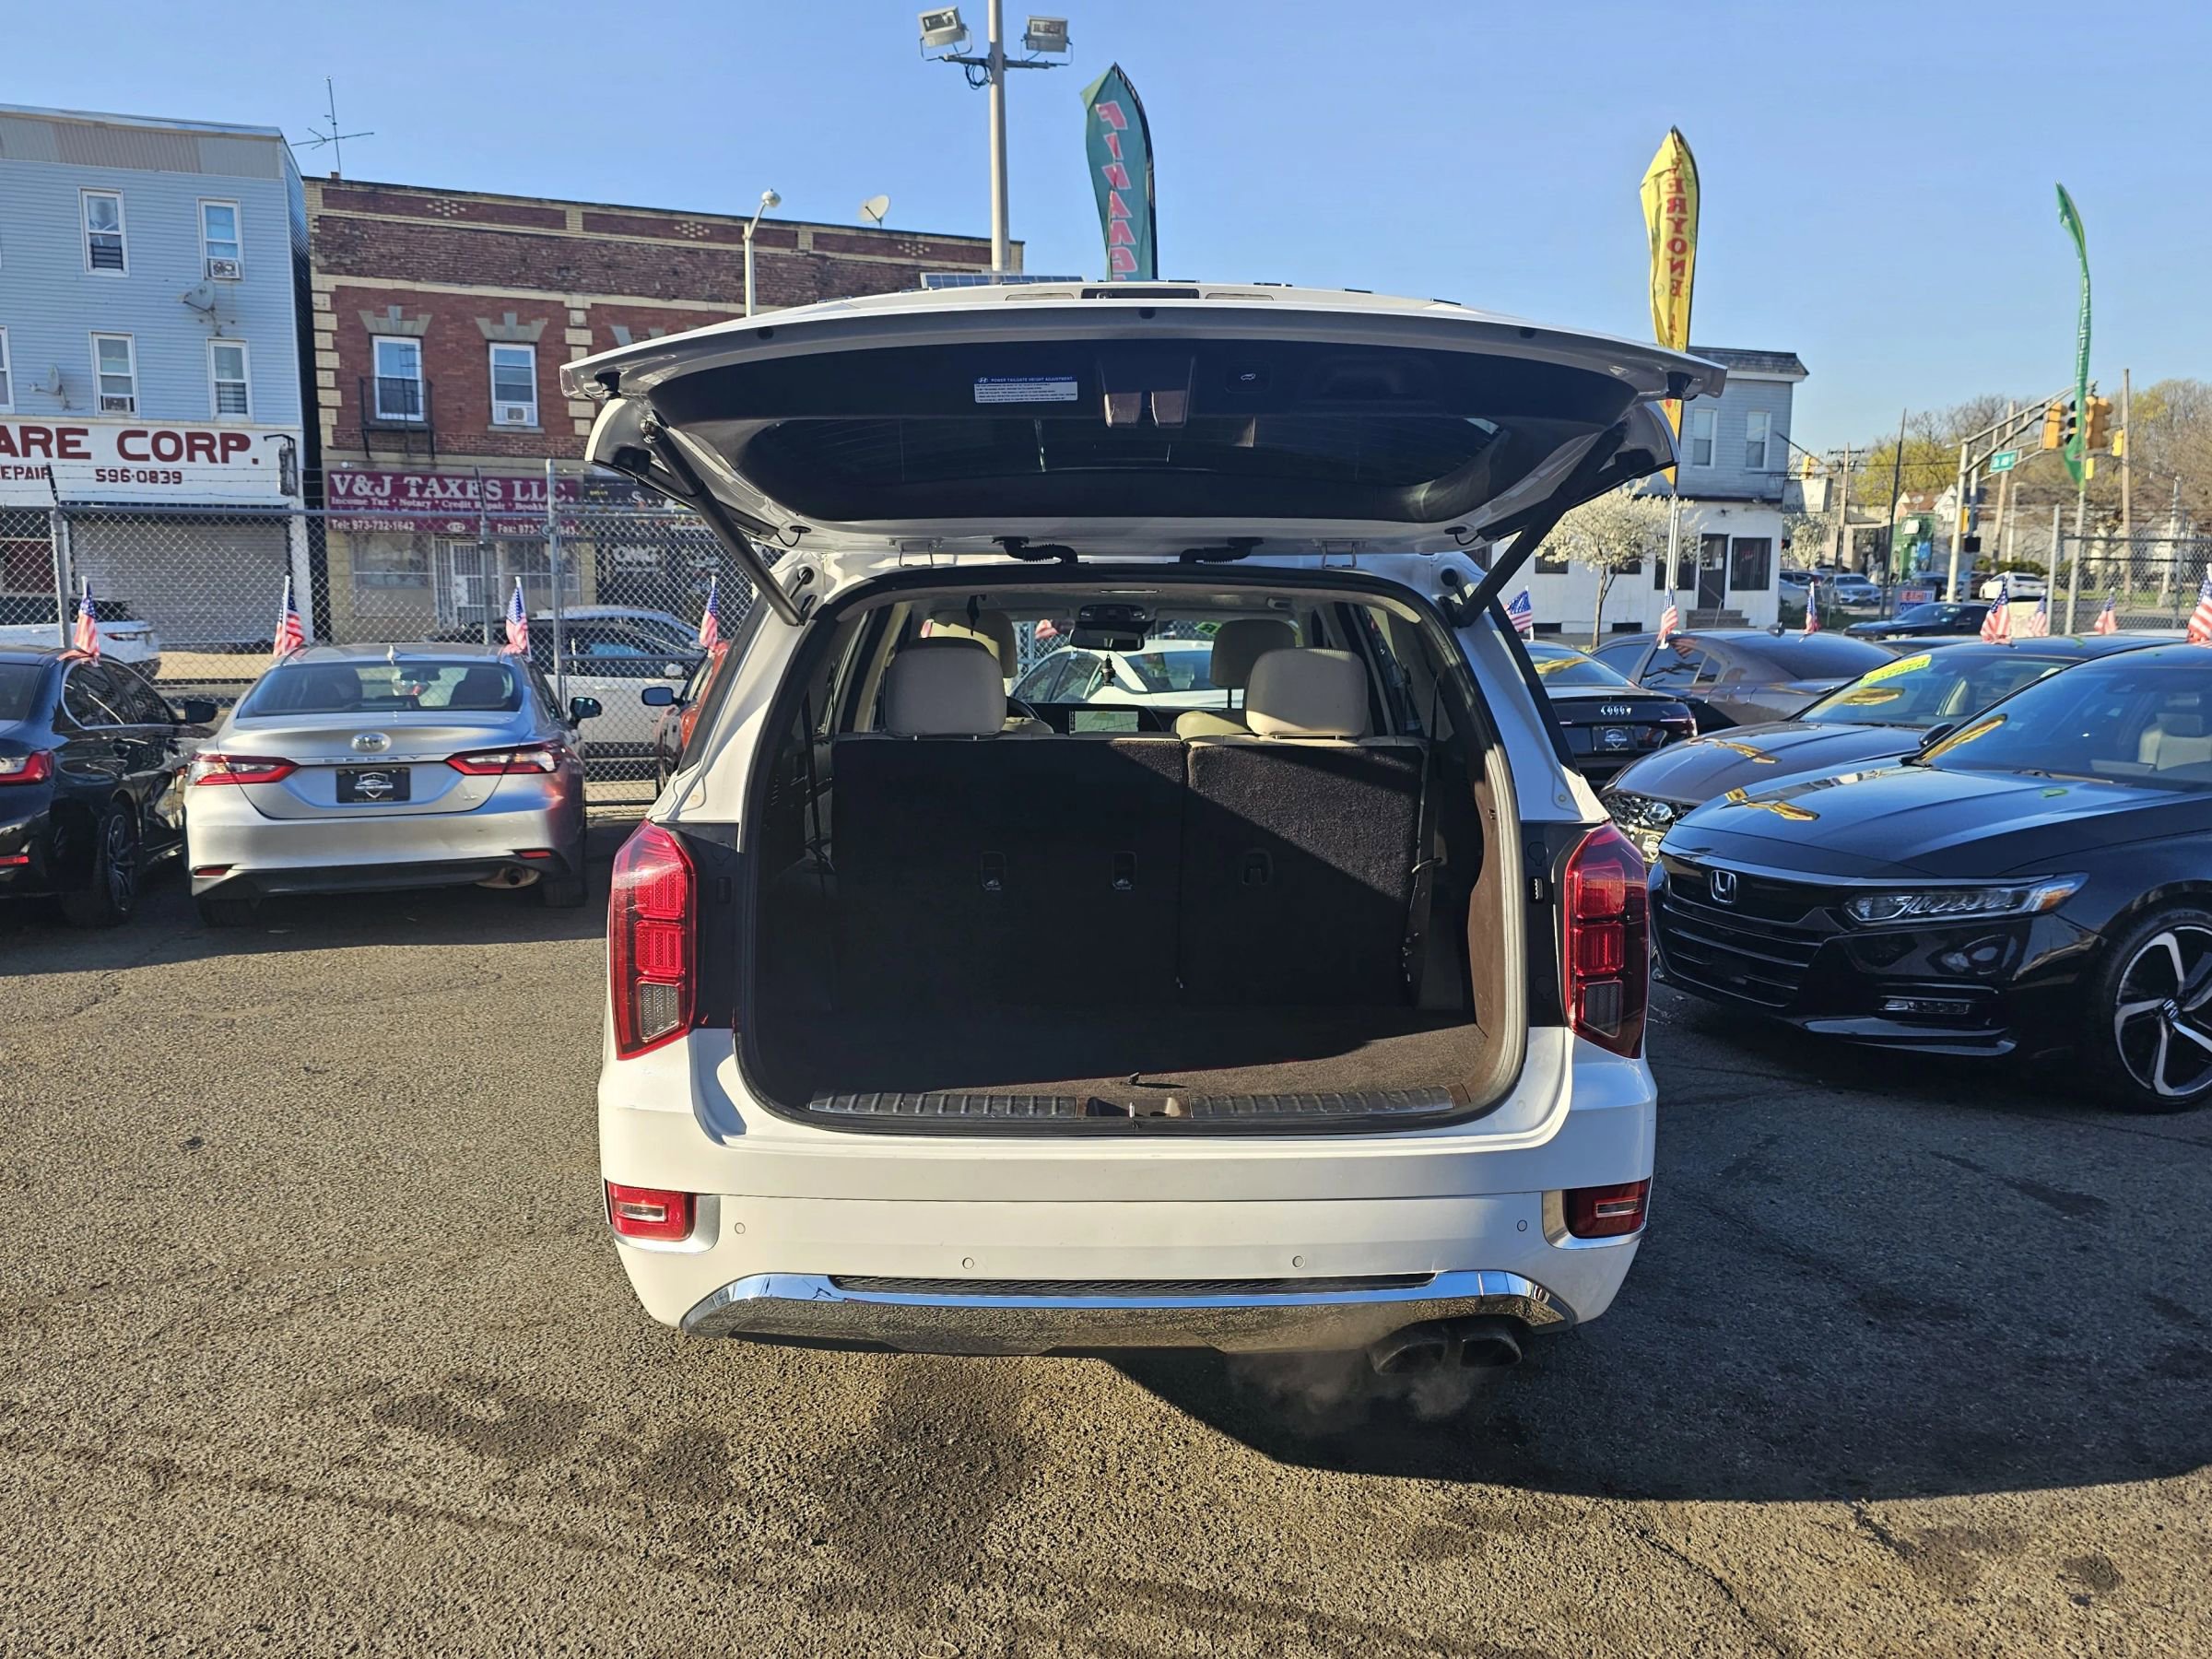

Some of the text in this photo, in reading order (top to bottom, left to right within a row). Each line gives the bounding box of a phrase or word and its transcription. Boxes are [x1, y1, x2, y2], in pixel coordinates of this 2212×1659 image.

[117, 429, 259, 465] CORP.
[331, 474, 393, 497] V&J
[404, 477, 502, 500] TAXES
[332, 497, 369, 506] Income
[371, 498, 390, 506] Tax
[399, 499, 431, 509] Notary
[441, 500, 472, 509] Credit
[475, 501, 506, 511] Rpair
